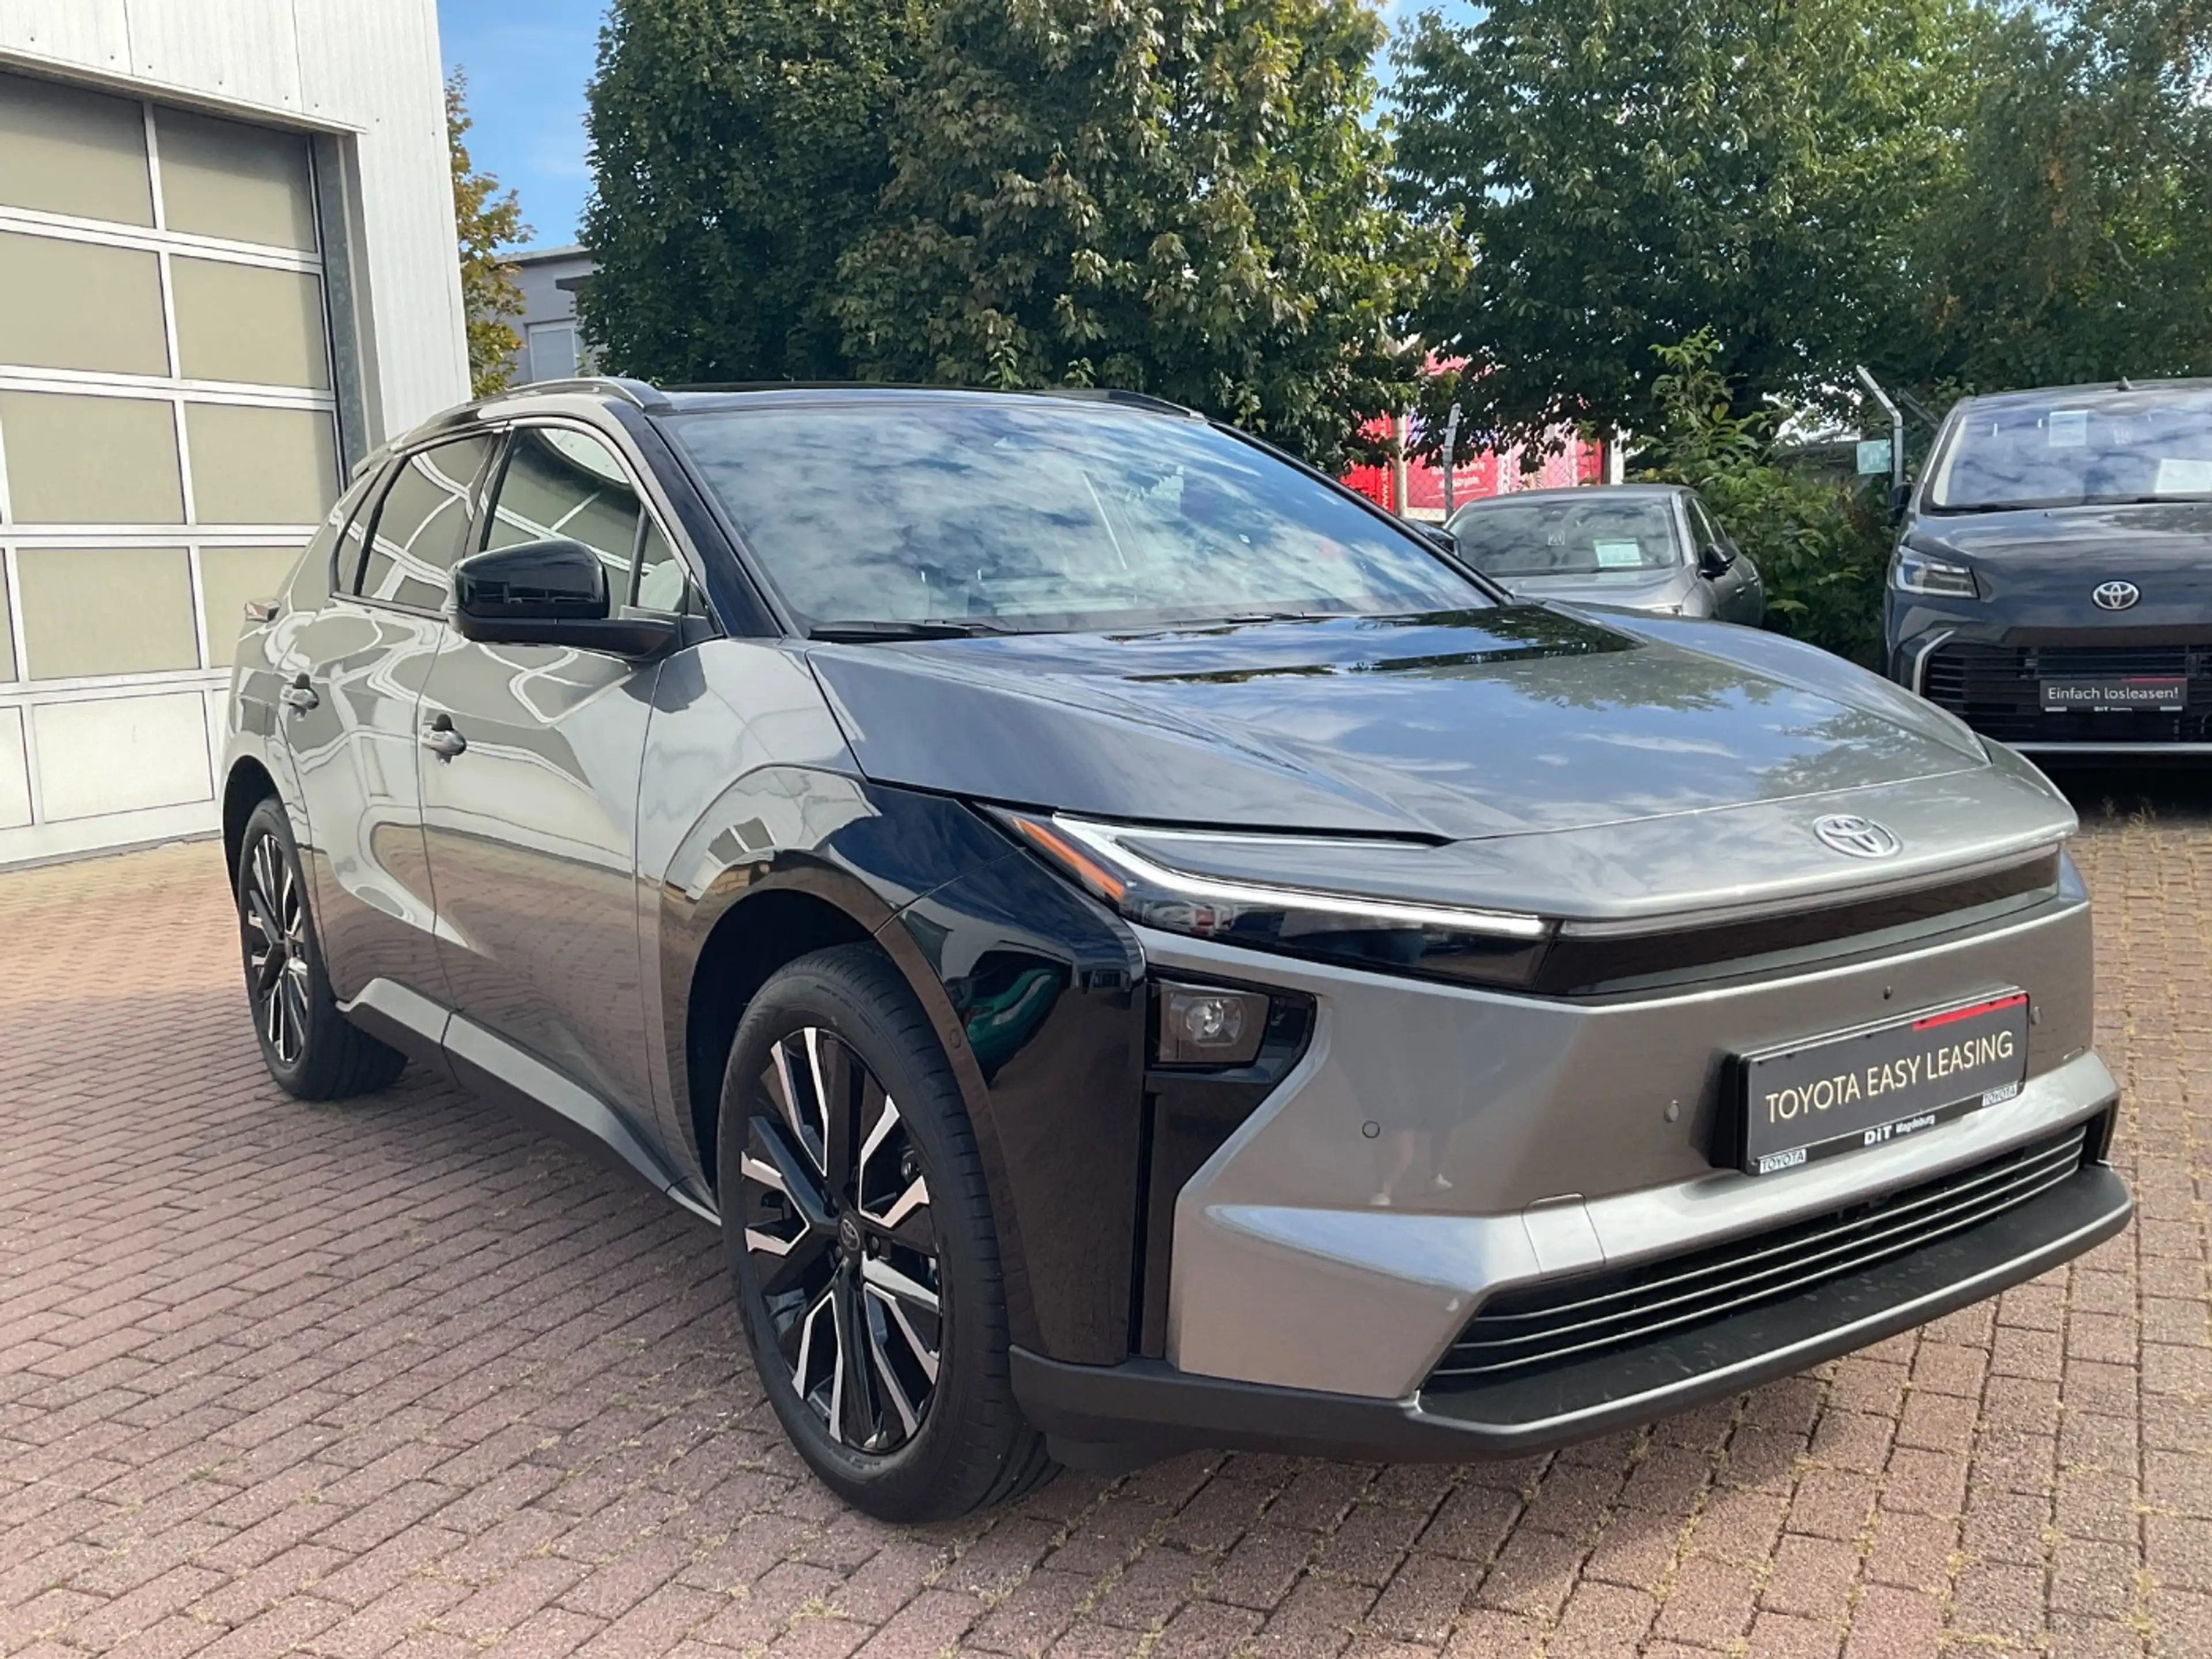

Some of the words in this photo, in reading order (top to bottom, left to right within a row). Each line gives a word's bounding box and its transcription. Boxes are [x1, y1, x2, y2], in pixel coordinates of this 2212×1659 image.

[2048, 687, 2100, 699] Einfach
[2104, 687, 2179, 699] losleasen!
[1765, 1073, 1861, 1123] TOYOTA
[1866, 1055, 1921, 1096] EASY
[1927, 1030, 2013, 1080] LEASING
[1762, 1150, 1805, 1172] TOYOTA
